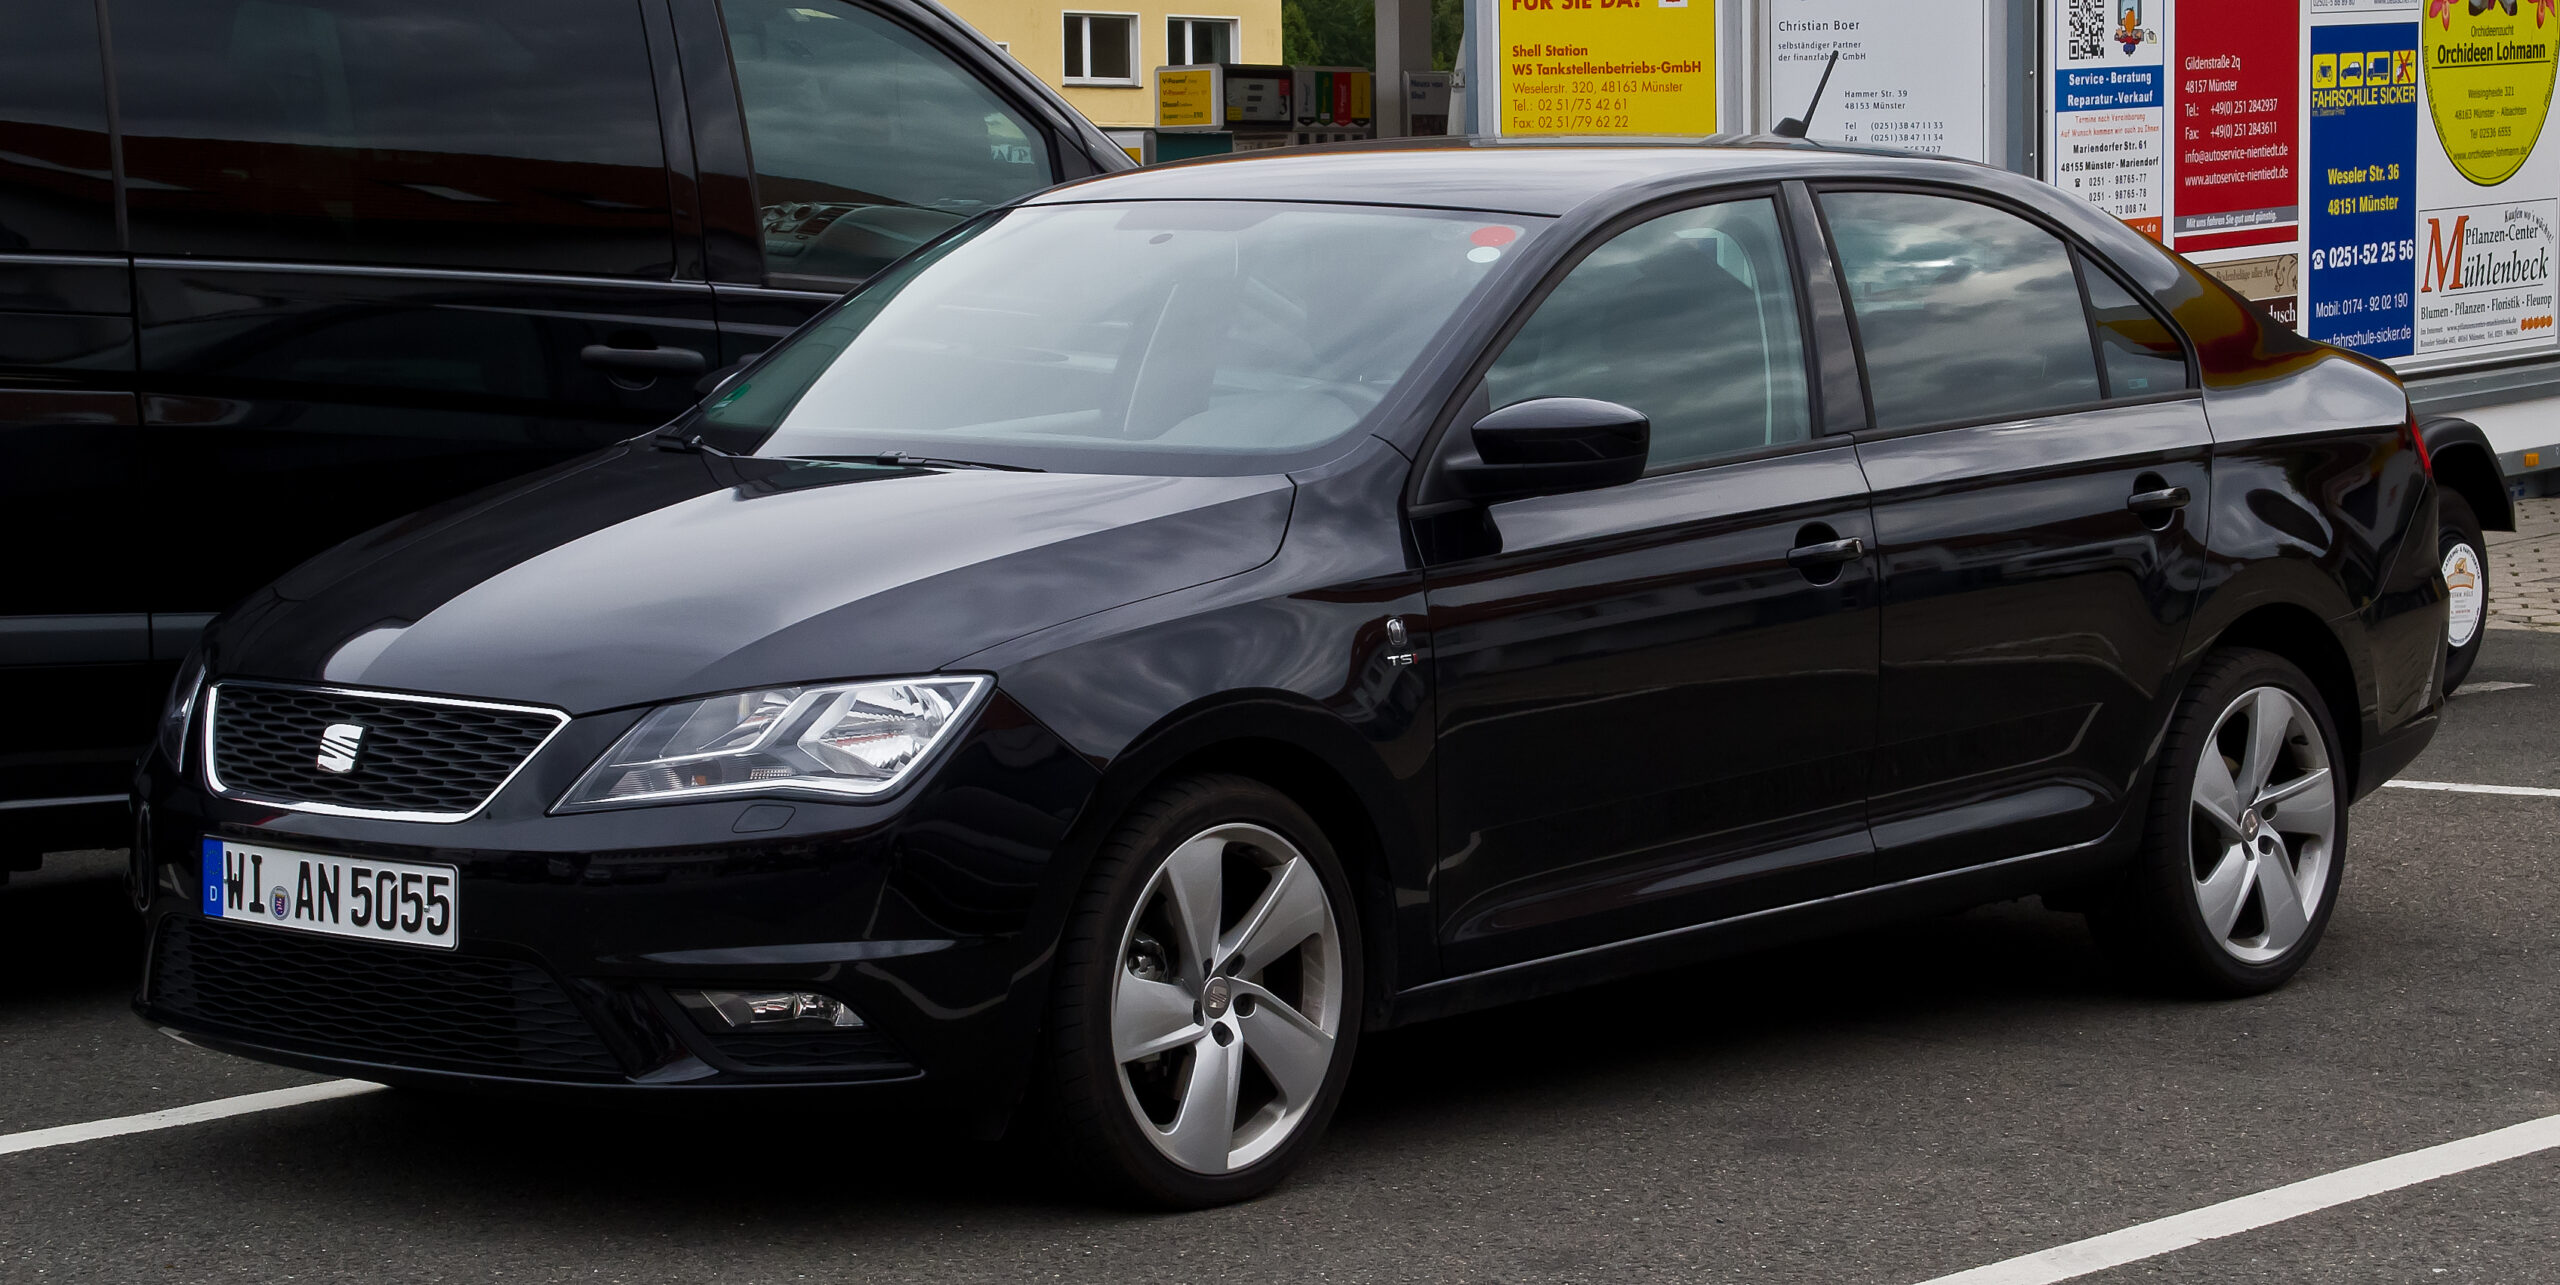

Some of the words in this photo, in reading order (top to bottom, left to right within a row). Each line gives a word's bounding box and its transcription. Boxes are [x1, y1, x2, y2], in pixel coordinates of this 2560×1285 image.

[1778, 21, 1828, 31] Christian
[1834, 20, 1860, 30] Boer
[1512, 45, 1541, 57] Shell
[1546, 44, 1588, 57] Station
[1778, 41, 1830, 50] selbständiger
[1833, 41, 1861, 49] Partner
[2438, 43, 2493, 64] Orchideen
[2497, 41, 2546, 62] Lohmann
[1793, 53, 1839, 61] finanzfab
[2185, 54, 2230, 70] Gildenstraße
[1512, 63, 1532, 76] WS
[1537, 60, 1702, 75] Tankstellenbetriebs-GmbH
[2069, 73, 2104, 85] Service
[2110, 71, 2152, 85] Beratung
[2185, 80, 2207, 93] 48157
[2208, 79, 2238, 92] Münster
[1513, 82, 1567, 94] Weselerstr.
[1572, 82, 1597, 95] 320,
[1602, 81, 1637, 93] 48163
[1642, 81, 1683, 92] Münster
[1845, 90, 1878, 98] Hammer
[1881, 90, 1895, 98] Str.
[2068, 92, 2113, 108] Reparatur
[2312, 88, 2378, 108] FAHRSCHULE
[2380, 86, 2416, 104] SICKER
[1538, 99, 1552, 111] 02
[1557, 98, 1592, 113] 51/75
[1596, 98, 1610, 110] 42
[1615, 98, 1627, 110] 61
[1845, 102, 1870, 110] 48153
[2234, 100, 2247, 114] 251
[2249, 98, 2278, 112] 2842937
[1514, 117, 1534, 128] Fax:
[1538, 117, 1552, 128] 02
[1557, 116, 1591, 130] 51/79
[1596, 116, 1610, 128] 62
[1615, 116, 1629, 127] 22
[1845, 122, 1857, 130] Tel
[2234, 123, 2247, 137] 251
[2249, 121, 2277, 136] 2843611
[2072, 128, 2092, 136] Wunsch
[2073, 142, 2122, 154] Mariendorfer
[2124, 141, 2137, 151] Str.
[2139, 140, 2147, 150] 61
[2185, 142, 2288, 164] info@autoservice-nientiedt.de
[2061, 162, 2083, 172] 48155
[2085, 160, 2115, 170] Münster
[2120, 156, 2159, 168] Mariendorf
[2089, 177, 2104, 187] 0251
[2185, 165, 2289, 187] www.autoservice-nientiedt.de
[2328, 167, 2367, 185] Weseler
[2370, 165, 2385, 181] Str.
[2388, 164, 2399, 180] 36
[2089, 192, 2104, 202] 0251
[2328, 198, 2356, 215] 48151
[2360, 195, 2399, 213] Münster
[2116, 205, 2123, 214] 73
[2139, 203, 2147, 212] 74
[2186, 218, 2195, 229] Mit
[2197, 218, 2206, 228] uns
[2207, 215, 2225, 227] fahren
[2226, 214, 2234, 225] Sie
[2234, 215, 2244, 227] gut
[2245, 212, 2255, 223] und
[2465, 224, 2539, 246] Pflanzen-Center
[2381, 241, 2396, 262] 25
[2399, 239, 2414, 260] 56
[2421, 215, 2549, 293] Mühlenbeck
[2316, 301, 2341, 318] Mobil:
[2343, 299, 2362, 315] 0174
[2370, 296, 2380, 311] 92
[2382, 295, 2392, 310] 02
[2394, 292, 2408, 308] 190
[2421, 307, 2449, 320] Blumen
[2455, 302, 2486, 317] Pflanzen
[2491, 296, 2521, 311] Floristik
[2526, 294, 2553, 309] Fleurop
[1387, 653, 1419, 666] TSI
[210, 886, 218, 901] D
[226, 851, 265, 913] WI
[295, 861, 340, 923] AN
[351, 867, 450, 935] 5055
